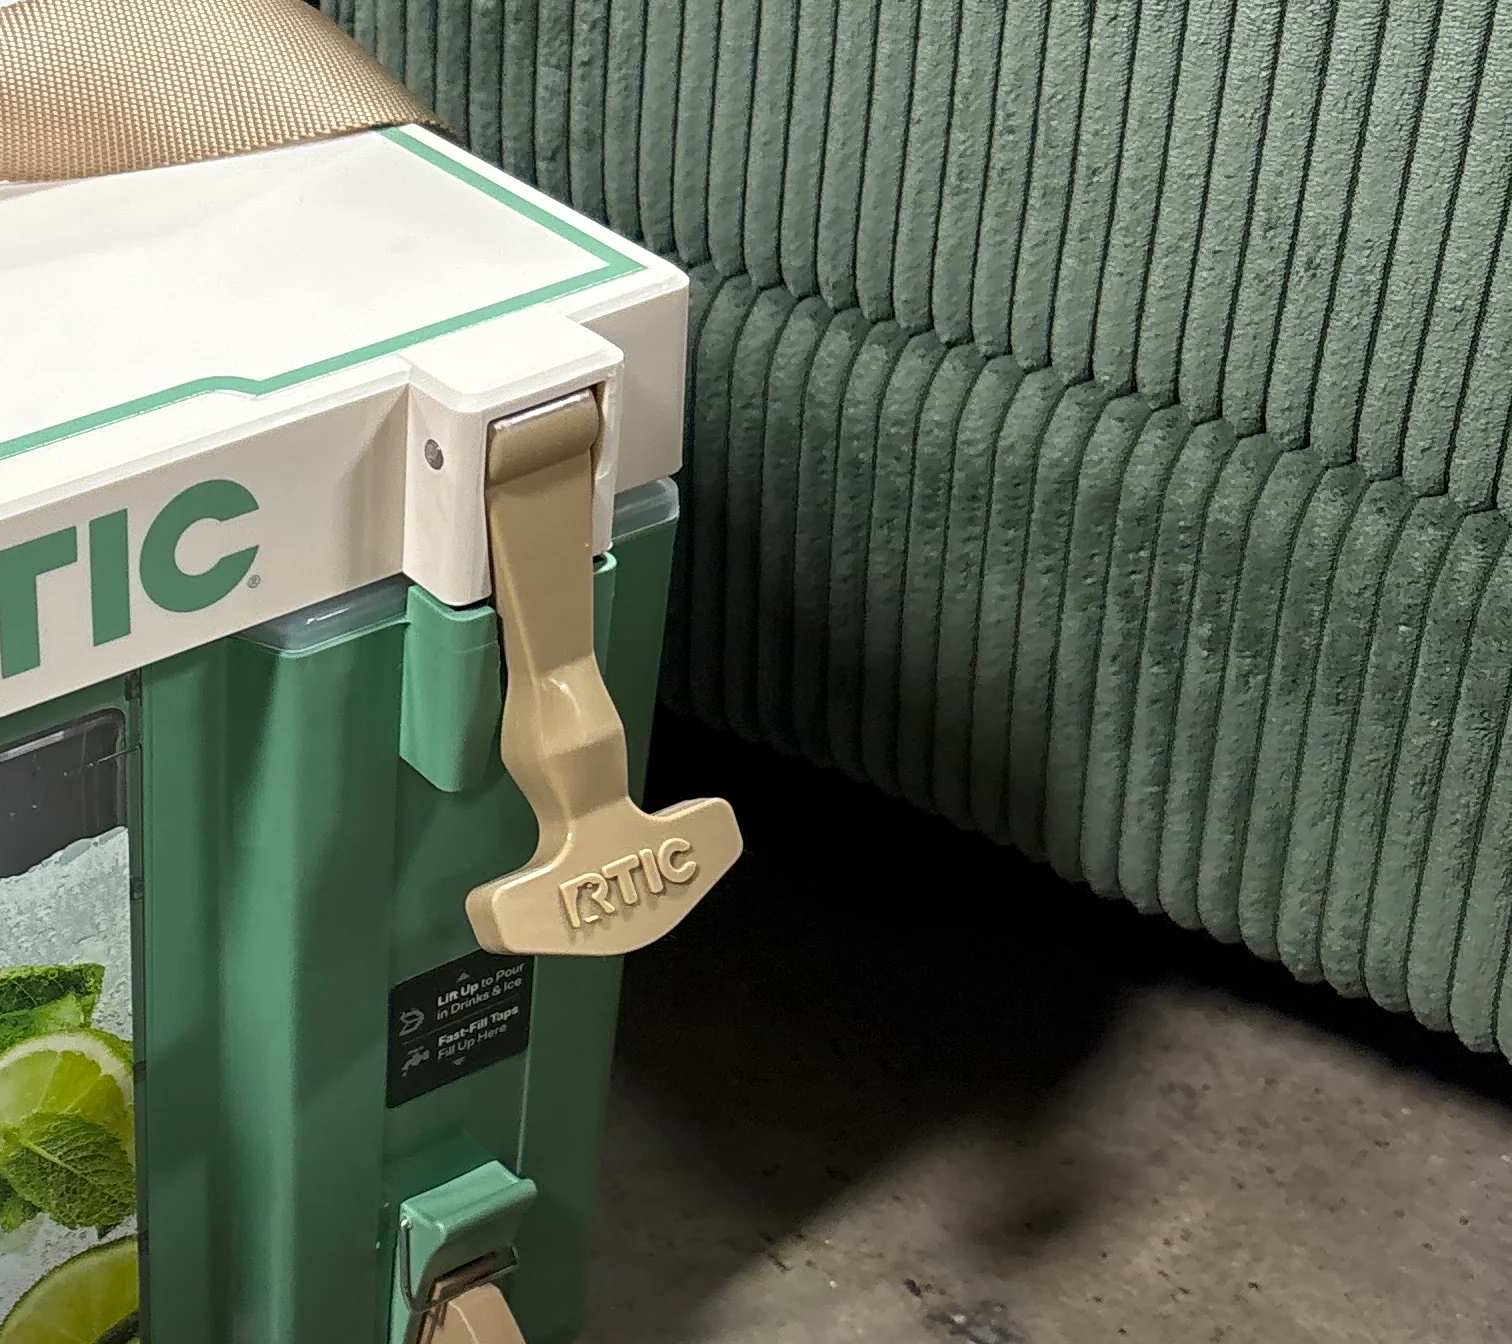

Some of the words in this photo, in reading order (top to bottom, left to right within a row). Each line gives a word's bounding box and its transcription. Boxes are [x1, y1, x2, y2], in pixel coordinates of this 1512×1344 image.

[559, 837, 698, 928] RTIC
[437, 1009, 448, 1021] in
[450, 990, 489, 1014] Drinks
[492, 985, 501, 996] &
[504, 977, 522, 991] Ice
[438, 990, 459, 1006] Lift
[460, 982, 479, 995] Up
[481, 976, 493, 988] to
[496, 962, 525, 982] Pour
[438, 1017, 488, 1047] Fast-Fill
[490, 1005, 519, 1024] Taps
[438, 1044, 456, 1061] Fill
[457, 1037, 475, 1051] Up
[478, 1024, 507, 1042] Here
